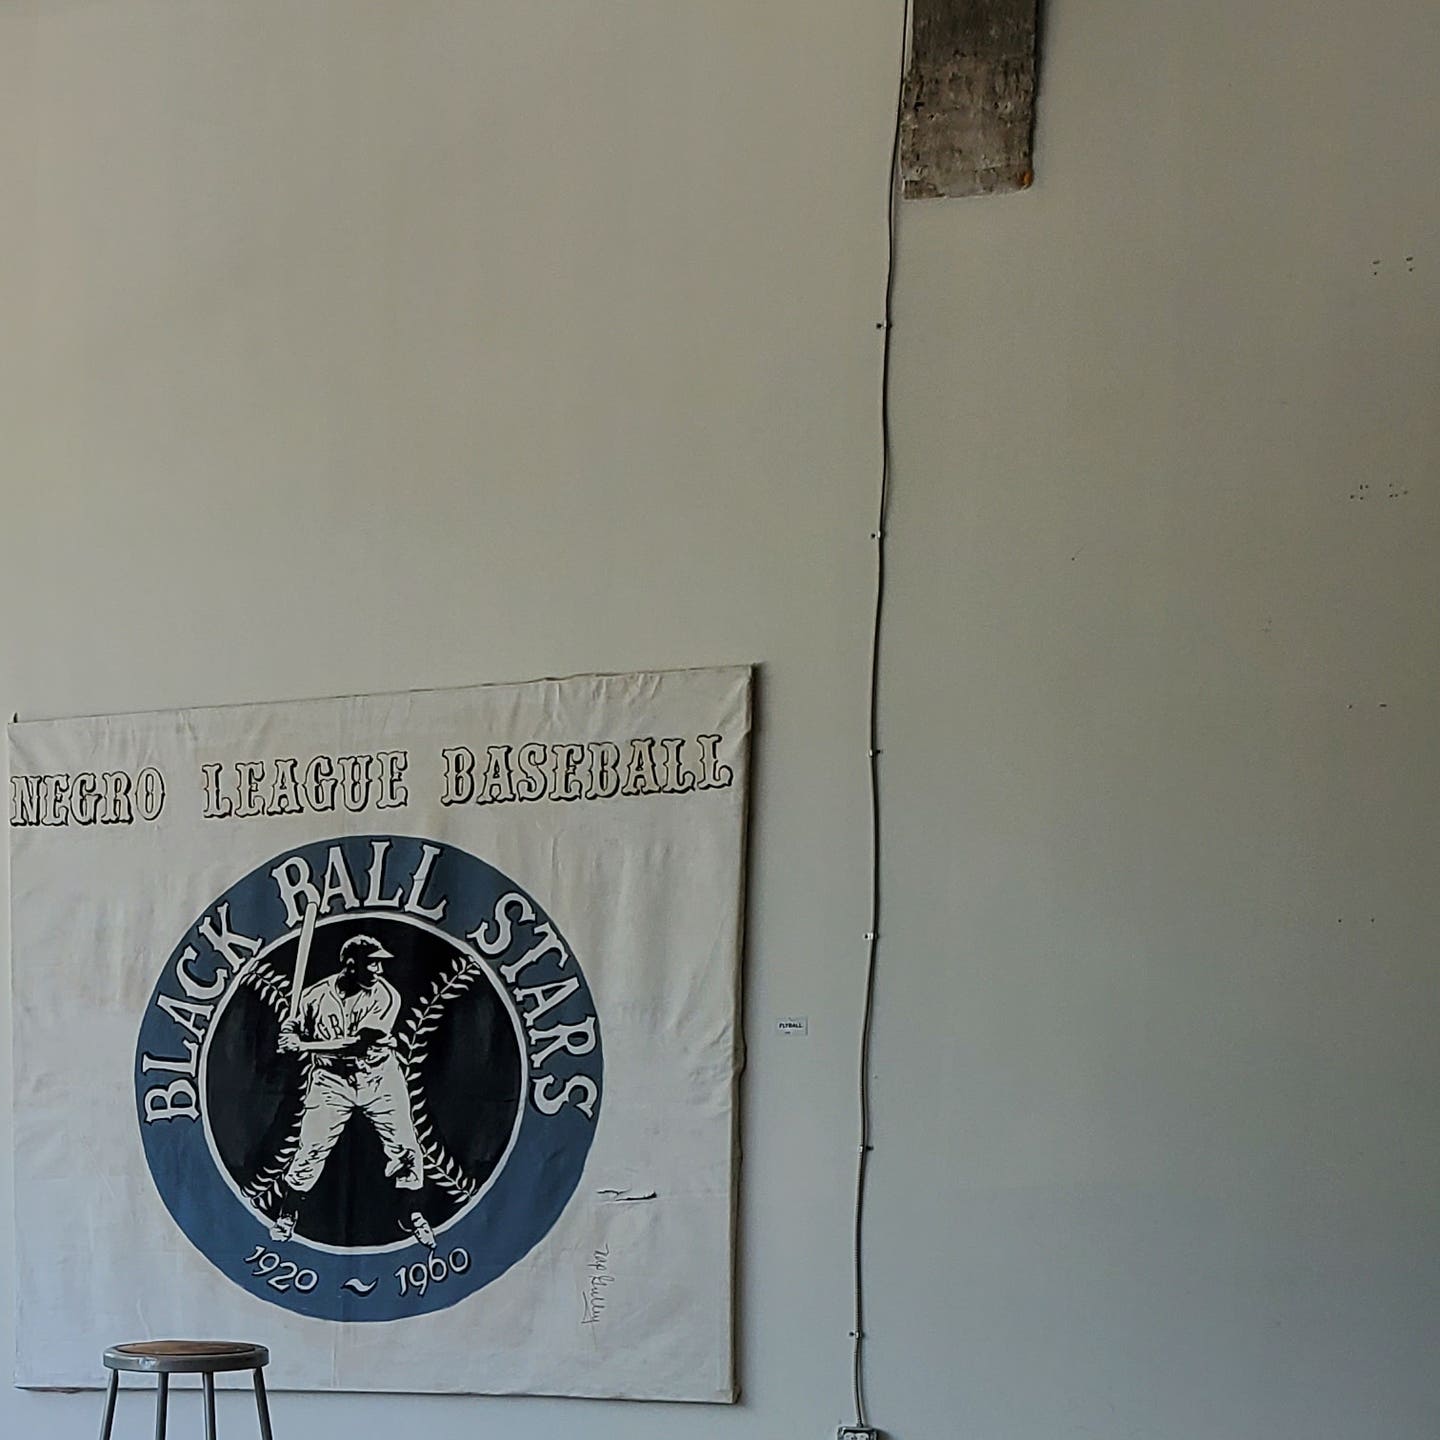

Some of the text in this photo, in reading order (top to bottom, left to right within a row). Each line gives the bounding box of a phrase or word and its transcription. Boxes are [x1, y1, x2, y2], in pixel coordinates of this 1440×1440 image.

[10, 734, 734, 826] NEGRO LEAGUE BASEBALL
[142, 841, 599, 1123] BLACK BALL STARS
[244, 1245, 318, 1292] 1920
[395, 1247, 471, 1297] 1960
